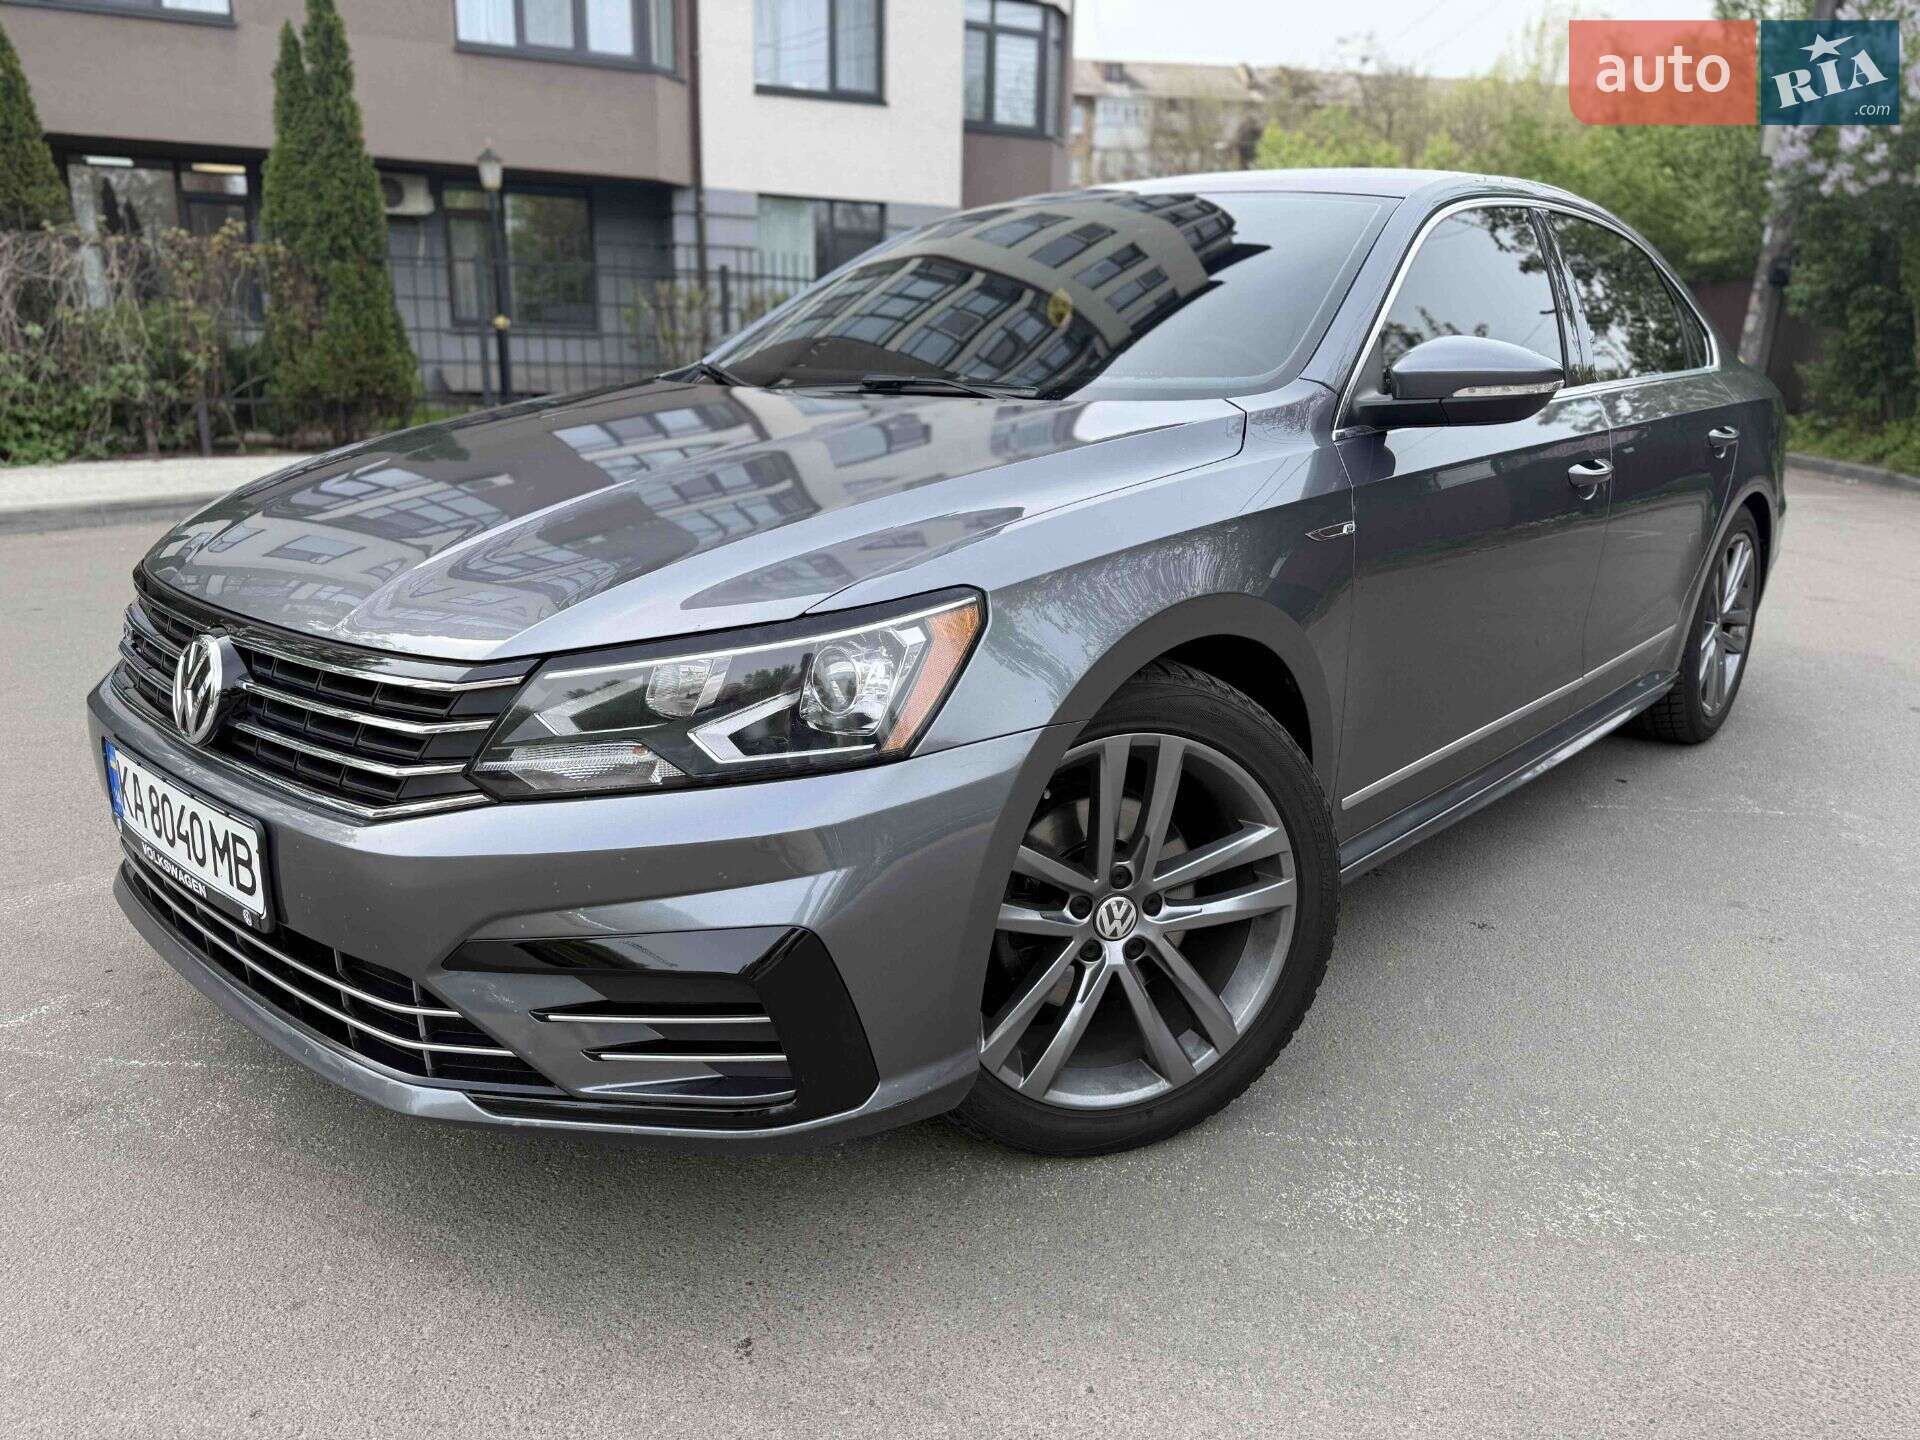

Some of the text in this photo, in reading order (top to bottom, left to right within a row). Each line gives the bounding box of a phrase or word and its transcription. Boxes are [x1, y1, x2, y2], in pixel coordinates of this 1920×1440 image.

[116, 759, 257, 897] KA 8040 MB
[141, 841, 208, 899] VOLKSWAGEN
